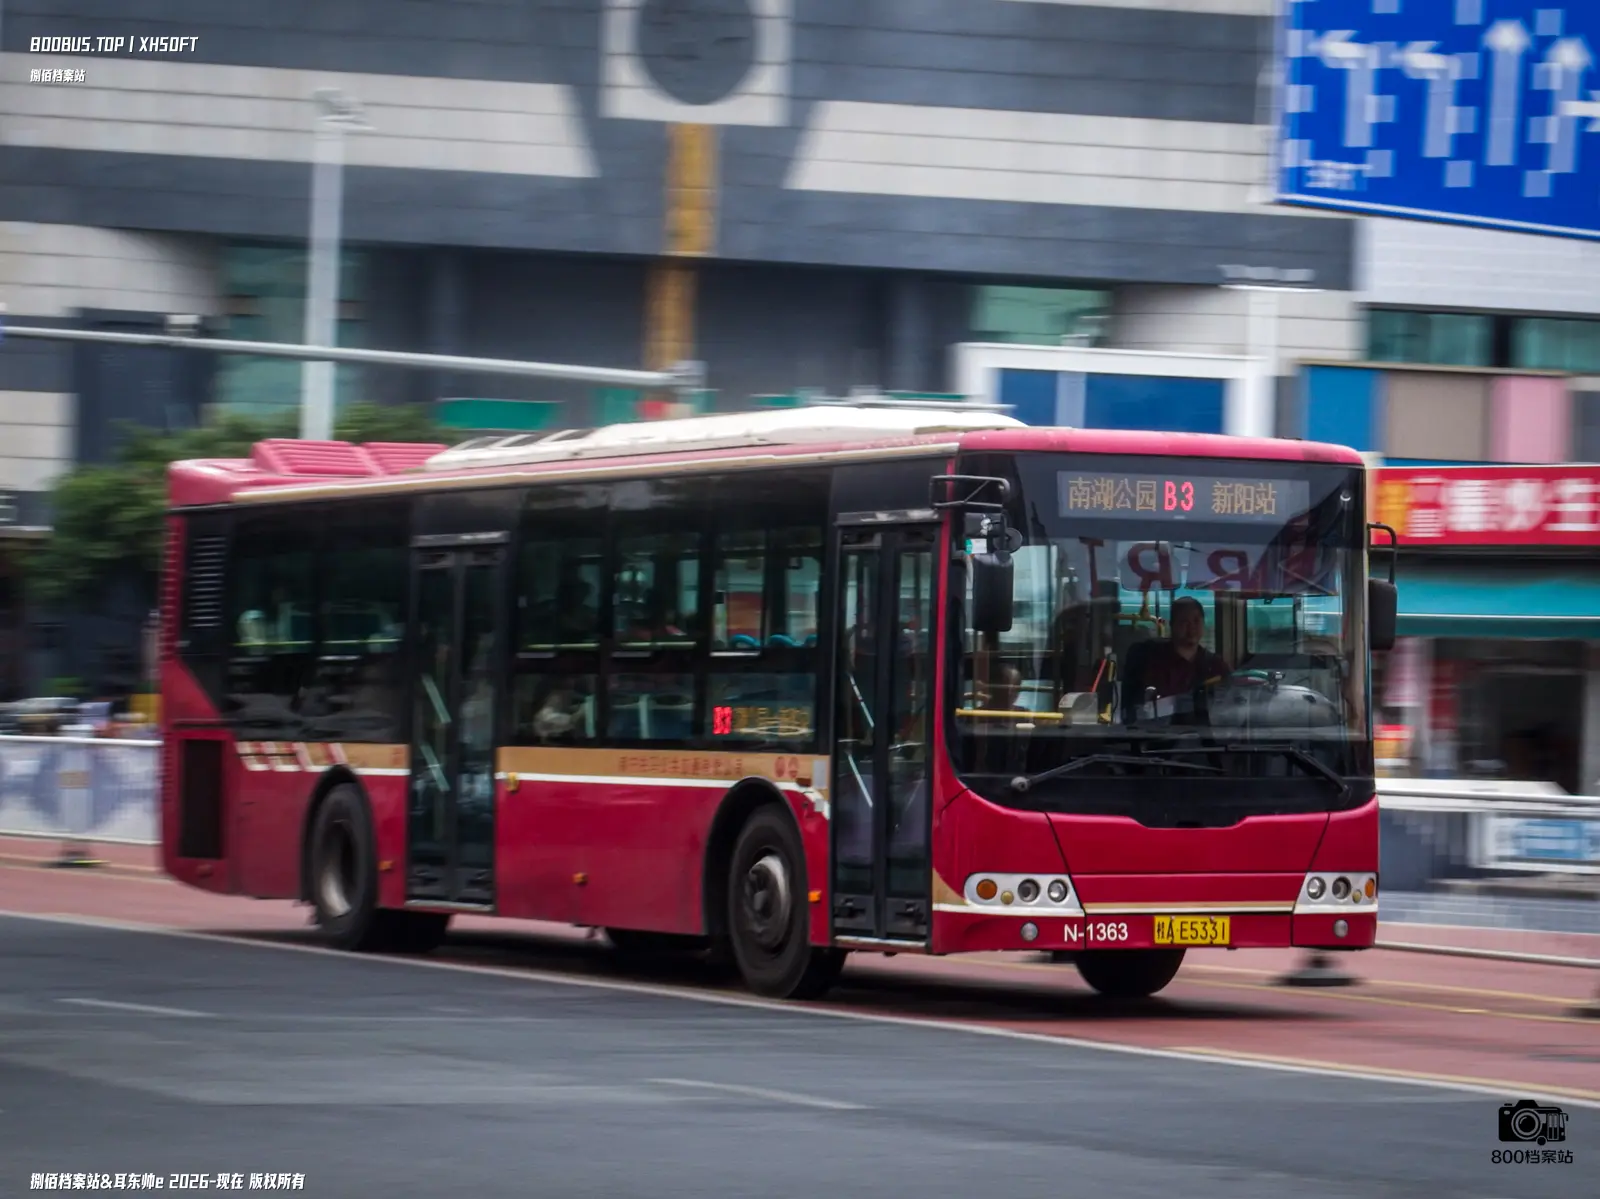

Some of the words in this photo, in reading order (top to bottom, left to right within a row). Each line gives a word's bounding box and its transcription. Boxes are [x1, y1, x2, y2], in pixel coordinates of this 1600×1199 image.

[1068, 477, 1157, 512] 南湖公园
[1163, 481, 1195, 511] B3
[1211, 482, 1278, 515] 新阳站
[1063, 922, 1128, 942] N-1363
